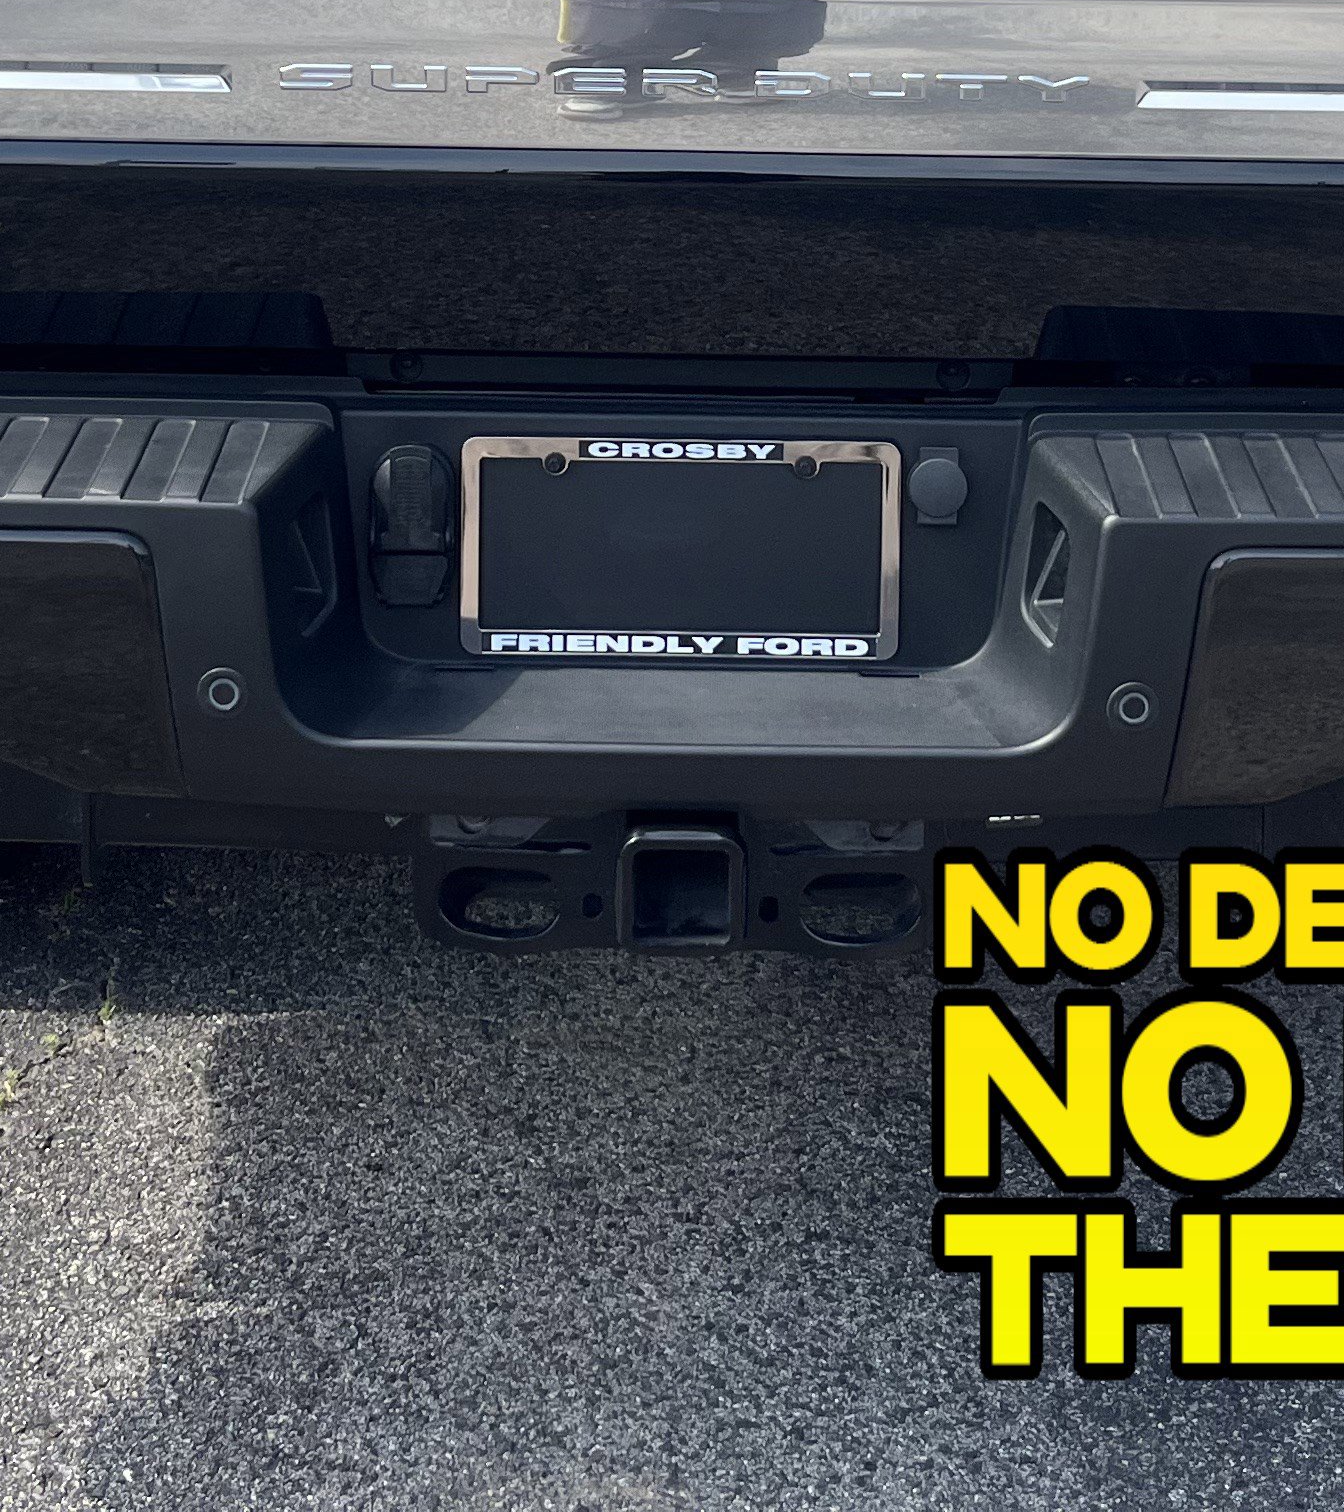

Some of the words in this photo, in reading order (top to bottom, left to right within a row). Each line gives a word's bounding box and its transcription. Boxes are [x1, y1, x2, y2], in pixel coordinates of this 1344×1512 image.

[278, 63, 719, 96] SUPER
[754, 70, 1091, 102] DUTY
[587, 441, 776, 460] CROSBY
[490, 633, 723, 654] FRIENDLY
[736, 636, 870, 657] FORD
